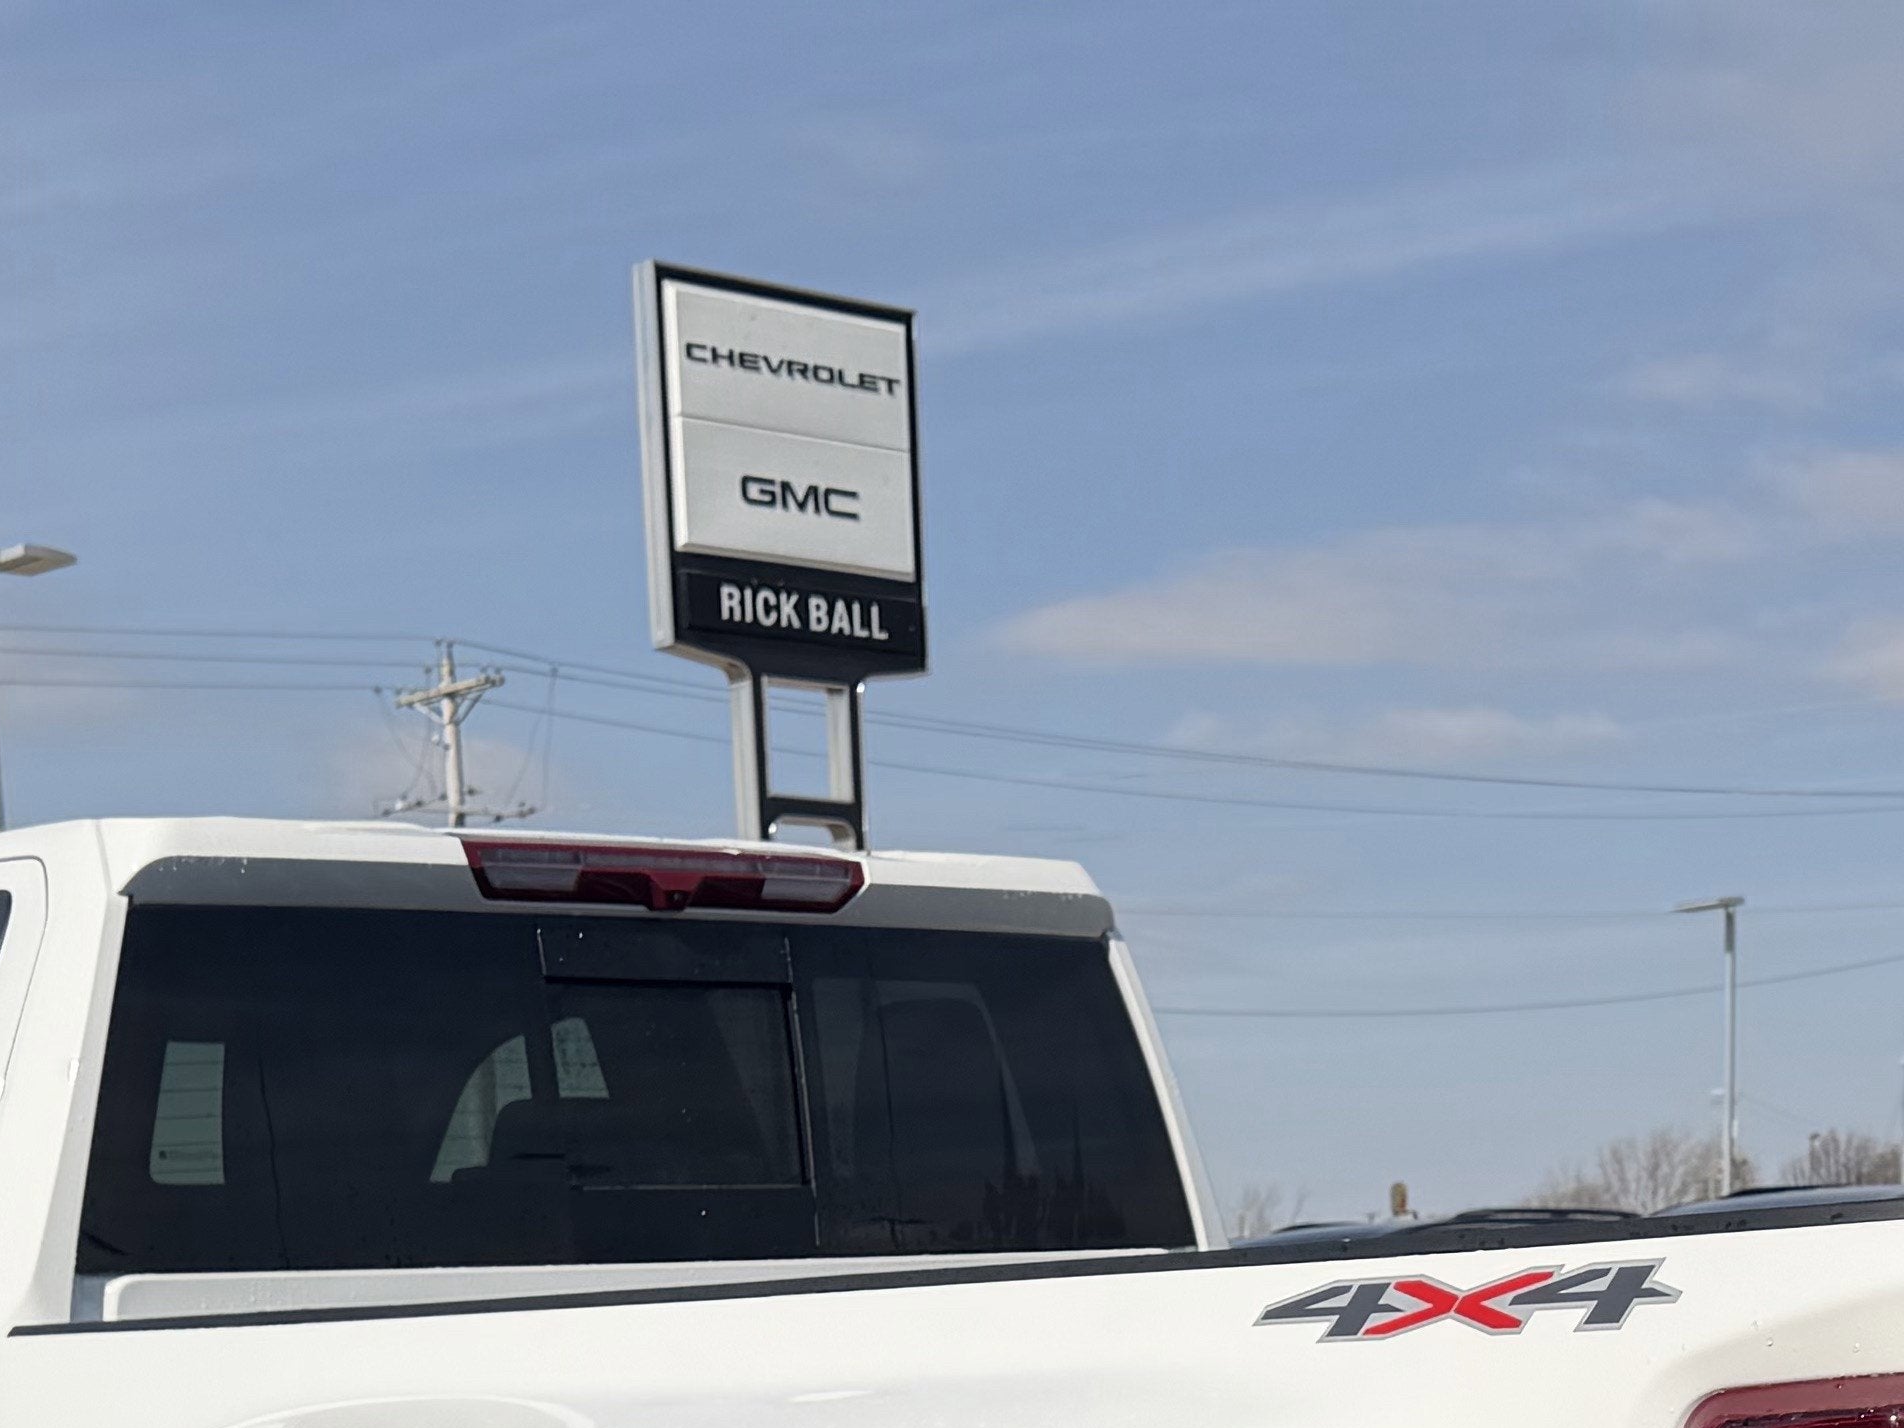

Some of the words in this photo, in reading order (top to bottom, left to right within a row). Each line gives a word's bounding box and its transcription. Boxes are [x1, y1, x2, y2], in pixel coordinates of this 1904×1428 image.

[685, 342, 900, 396] CHEVROLET
[741, 474, 860, 521] GMC
[719, 583, 801, 630] RICK
[808, 593, 889, 641] BALL
[1253, 1257, 1682, 1343] 4X4
